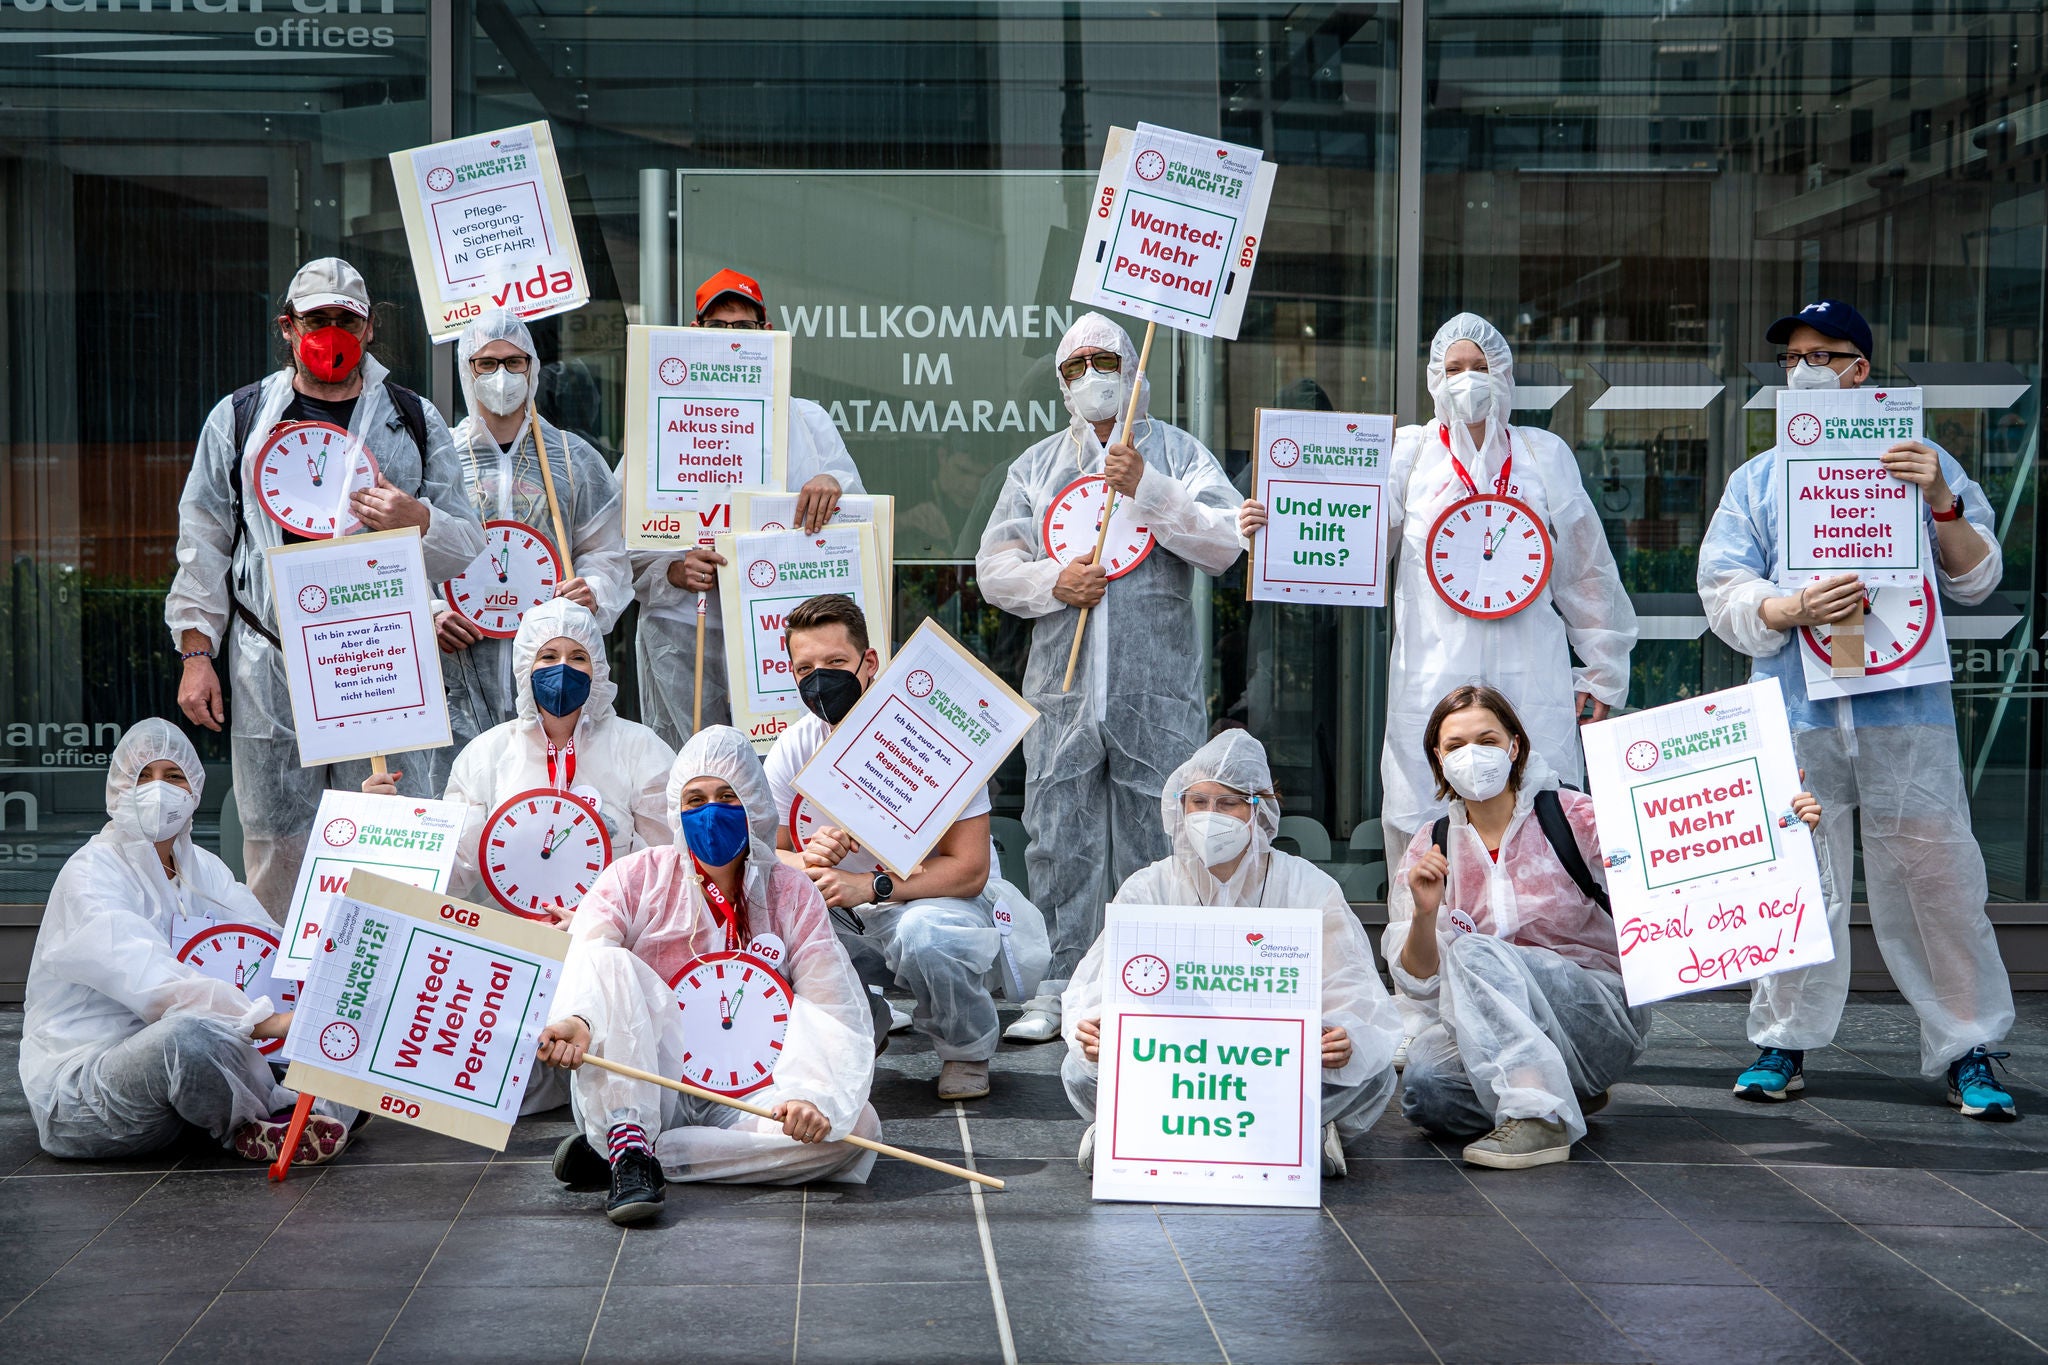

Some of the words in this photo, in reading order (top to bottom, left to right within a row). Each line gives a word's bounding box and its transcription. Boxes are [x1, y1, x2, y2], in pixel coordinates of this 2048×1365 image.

[254, 19, 394, 47] offices
[464, 205, 507, 219] Pflege-
[452, 215, 524, 236] versorgung-
[1131, 209, 1223, 250] Wanted:
[463, 226, 523, 247] Sicherheit
[455, 252, 468, 264] IN
[476, 238, 535, 259] GEFAHR!
[1140, 238, 1198, 268] Mehr
[492, 265, 573, 307] vida
[1114, 256, 1212, 298] Personal
[443, 302, 481, 322] vida
[780, 305, 1072, 338] WILLKOMMEN
[690, 362, 708, 371] FÜR
[903, 353, 953, 385] IM
[690, 372, 698, 381] 5
[700, 372, 738, 382] NACH
[741, 374, 761, 383] 12!
[683, 404, 740, 417] Unsere
[829, 400, 1056, 432] ATAMARAN
[667, 421, 717, 433] Akkus
[721, 420, 755, 434] sind
[1825, 417, 1847, 427] FÜR
[1878, 418, 1896, 426] IST
[1900, 418, 1913, 426] ES
[693, 437, 730, 450] leer:
[1825, 429, 1834, 440] 5
[1838, 428, 1885, 439] NACH
[1888, 427, 1912, 438] 12!
[1303, 444, 1322, 453] FÜR
[1325, 446, 1345, 454] UNS
[1366, 448, 1379, 456] ES
[679, 454, 742, 467] Handelt
[1303, 454, 1310, 464] 5
[1314, 455, 1354, 466] NACH
[1357, 457, 1377, 467] 12!
[678, 471, 743, 483] endlich!
[1818, 467, 1887, 480] Unsere
[1799, 486, 1859, 500] Akkus
[1865, 484, 1906, 499] sind
[1276, 497, 1322, 516] Und
[1328, 502, 1371, 518] wer
[1831, 505, 1875, 518] leer:
[642, 515, 680, 532] vida
[1299, 522, 1345, 542] hilft
[1814, 524, 1892, 539] Handelt
[1293, 549, 1349, 567] uns?
[1813, 543, 1893, 558] endlich!
[779, 561, 797, 570] FÜR
[800, 561, 818, 569] UNS
[820, 560, 834, 568] IST
[837, 559, 849, 567] ES
[780, 572, 788, 581] 5
[790, 569, 827, 580] NACH
[830, 567, 849, 577] 12!
[485, 590, 518, 605] vida
[314, 632, 328, 641] Ich
[330, 630, 344, 639] bin
[347, 628, 370, 637] zwar
[341, 640, 364, 649] Aber
[366, 637, 380, 646] die
[318, 649, 384, 666] Unfähigkeit
[388, 646, 406, 655] der
[335, 661, 394, 676] Regierung
[334, 680, 359, 689] kann
[361, 676, 374, 685] ich
[376, 673, 398, 683] nicht
[341, 692, 363, 701] nicht
[365, 688, 395, 698] heilen!
[750, 717, 788, 736] vida
[894, 713, 905, 725] Ich
[906, 722, 918, 736] bin
[917, 734, 936, 750] zwar
[935, 748, 952, 765] Arzt.
[874, 730, 925, 776] Unfähigkeit
[924, 773, 940, 789] der
[900, 736, 918, 752] Aber
[918, 750, 930, 764] die
[875, 751, 919, 792] Regierung
[864, 760, 884, 779] kann
[883, 776, 895, 789] ich
[895, 786, 913, 804] nicht
[858, 775, 878, 793] nicht
[877, 792, 902, 812] heilen!
[1643, 778, 1753, 818] Wanted:
[1669, 807, 1735, 838] Mehr
[358, 834, 366, 844] 5
[370, 834, 416, 849] NACH
[418, 841, 442, 852] 12!
[361, 825, 383, 836] FÜR
[386, 828, 408, 837] UNS
[411, 830, 429, 839] IST
[431, 832, 445, 841] ES
[1650, 825, 1763, 868] Personal
[338, 913, 351, 944] Offensive
[344, 906, 360, 945] Gesundheit
[1620, 904, 1693, 956] Sozial
[1707, 903, 1747, 932] oba
[370, 922, 389, 950] 12!
[1260, 944, 1299, 952] Offensive
[1260, 951, 1310, 959] Gesundheit
[336, 991, 352, 1016] FÜR
[345, 961, 361, 988] UNS
[355, 937, 368, 958] IST
[362, 918, 375, 935] ES
[1176, 961, 1207, 975] FÜR
[1212, 965, 1245, 976] UNS
[1250, 966, 1275, 977] IST
[1280, 967, 1300, 977] ES
[351, 953, 379, 1007] NACH
[1176, 976, 1188, 990] 5
[1192, 977, 1258, 992] NACH
[1264, 979, 1297, 993] 12!
[347, 1009, 361, 1020] 5
[395, 946, 453, 1069] Wanted:
[433, 979, 474, 1056] Mehr
[454, 961, 513, 1091] Personal
[1132, 1038, 1208, 1064] Und
[1217, 1045, 1290, 1066] wer
[1172, 1072, 1247, 1101] hilft
[1162, 1111, 1255, 1137] uns?
